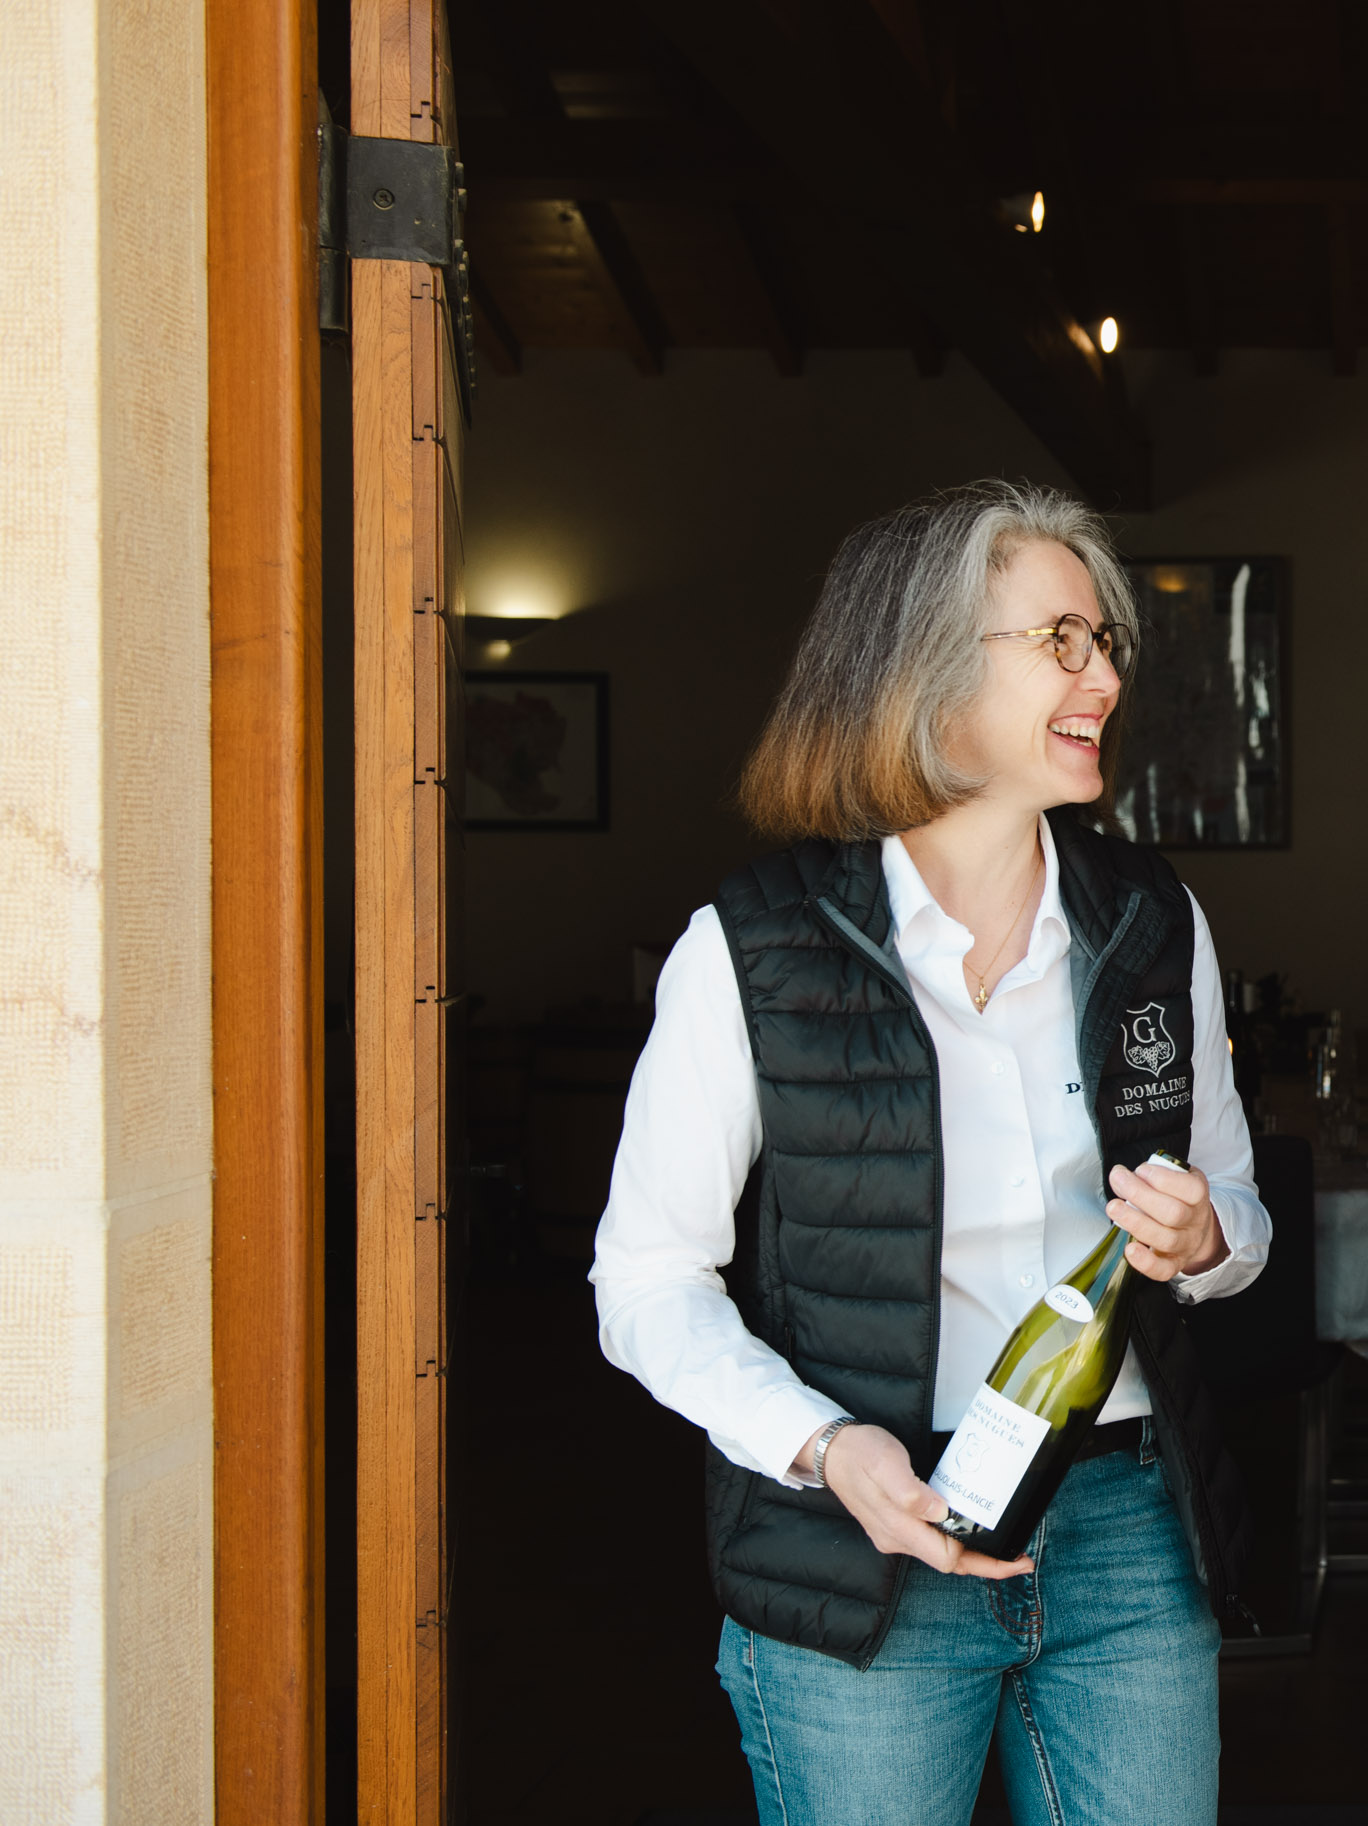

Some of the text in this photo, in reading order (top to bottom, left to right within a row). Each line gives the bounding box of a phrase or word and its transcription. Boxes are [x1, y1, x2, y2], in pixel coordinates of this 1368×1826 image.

[1132, 1016, 1157, 1043] G
[1065, 1082, 1084, 1095] D
[1122, 1076, 1187, 1101] DOMAINE
[1114, 1102, 1143, 1118] DES
